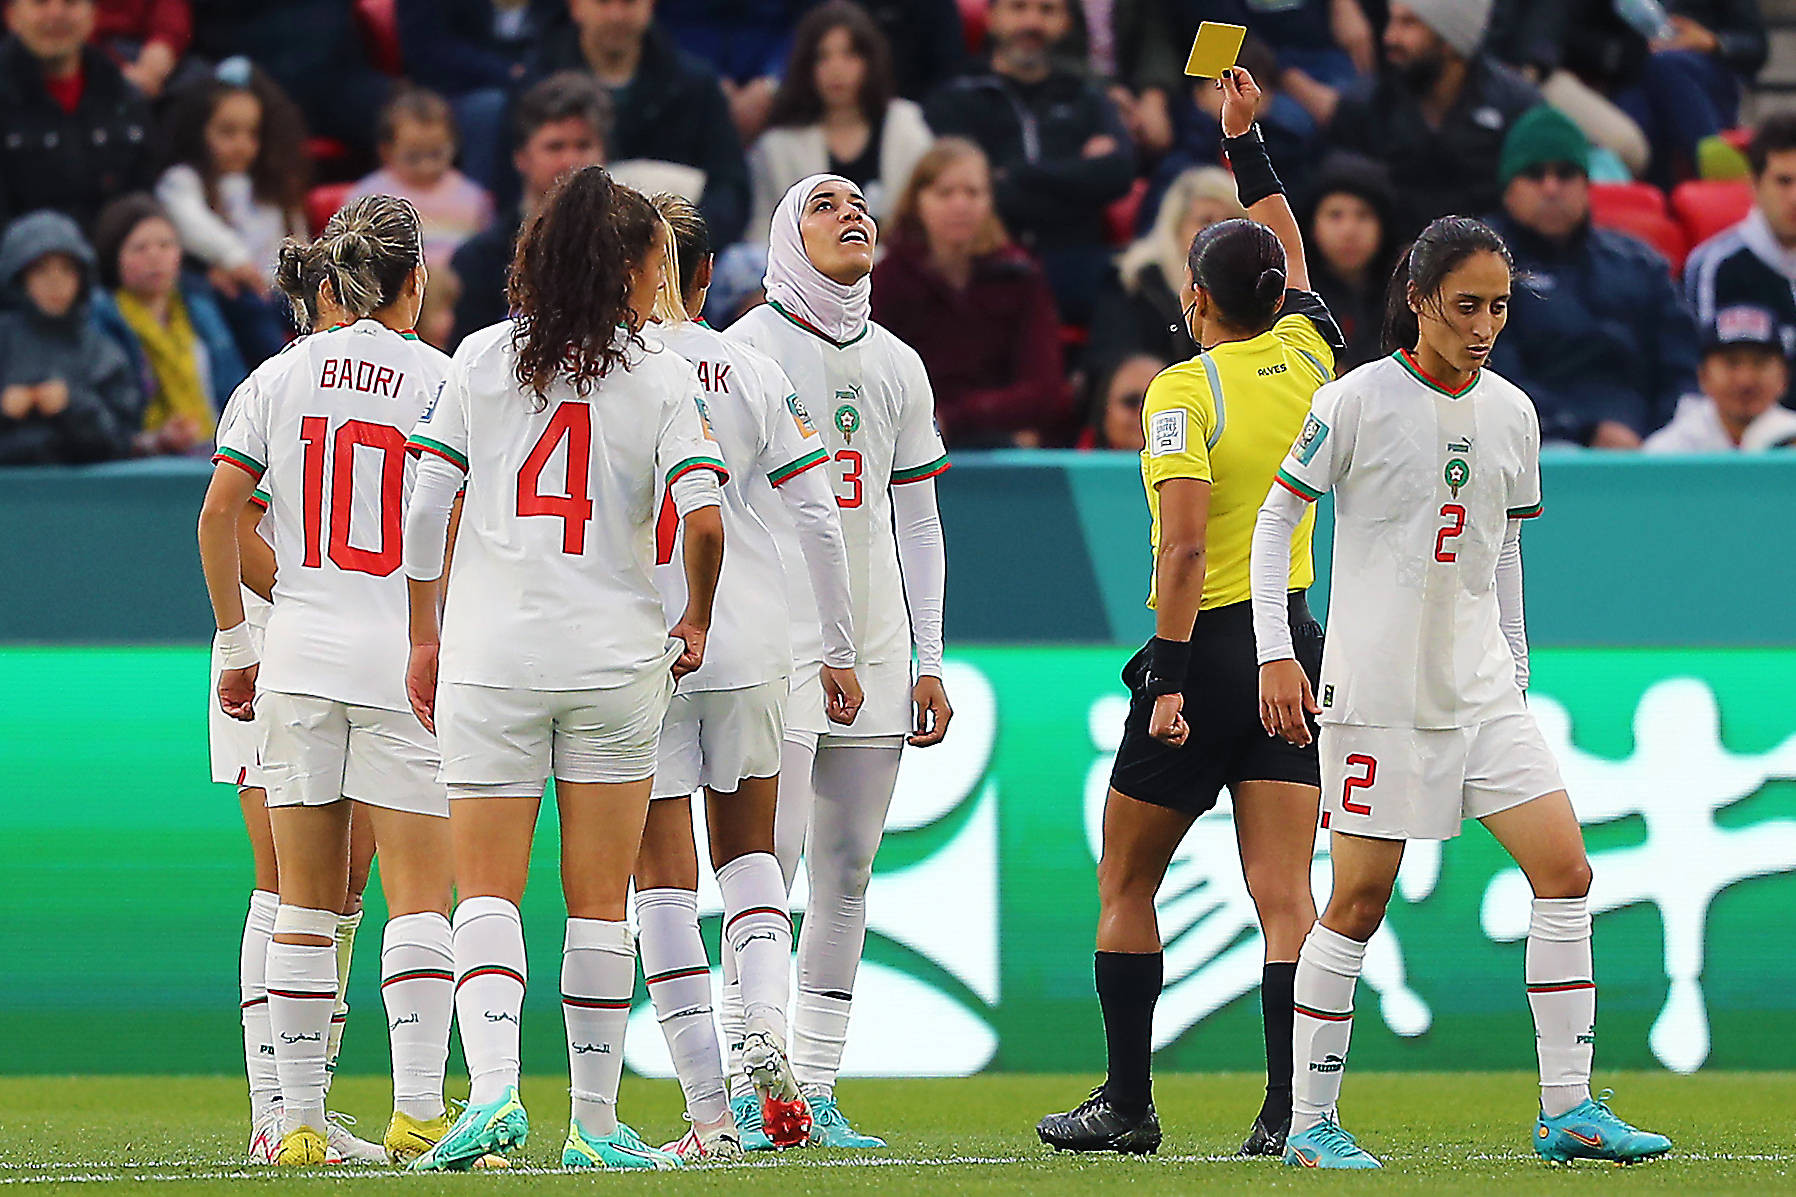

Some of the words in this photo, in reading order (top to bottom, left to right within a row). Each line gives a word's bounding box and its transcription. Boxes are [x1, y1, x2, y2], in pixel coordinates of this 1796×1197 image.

[320, 358, 404, 399] BADRI
[697, 361, 731, 394] AK
[1257, 362, 1288, 376] ALVES
[299, 415, 409, 578] 10
[516, 401, 593, 555] 4
[834, 449, 863, 508] 3
[1434, 504, 1466, 562] 2
[1342, 753, 1377, 816] 2
